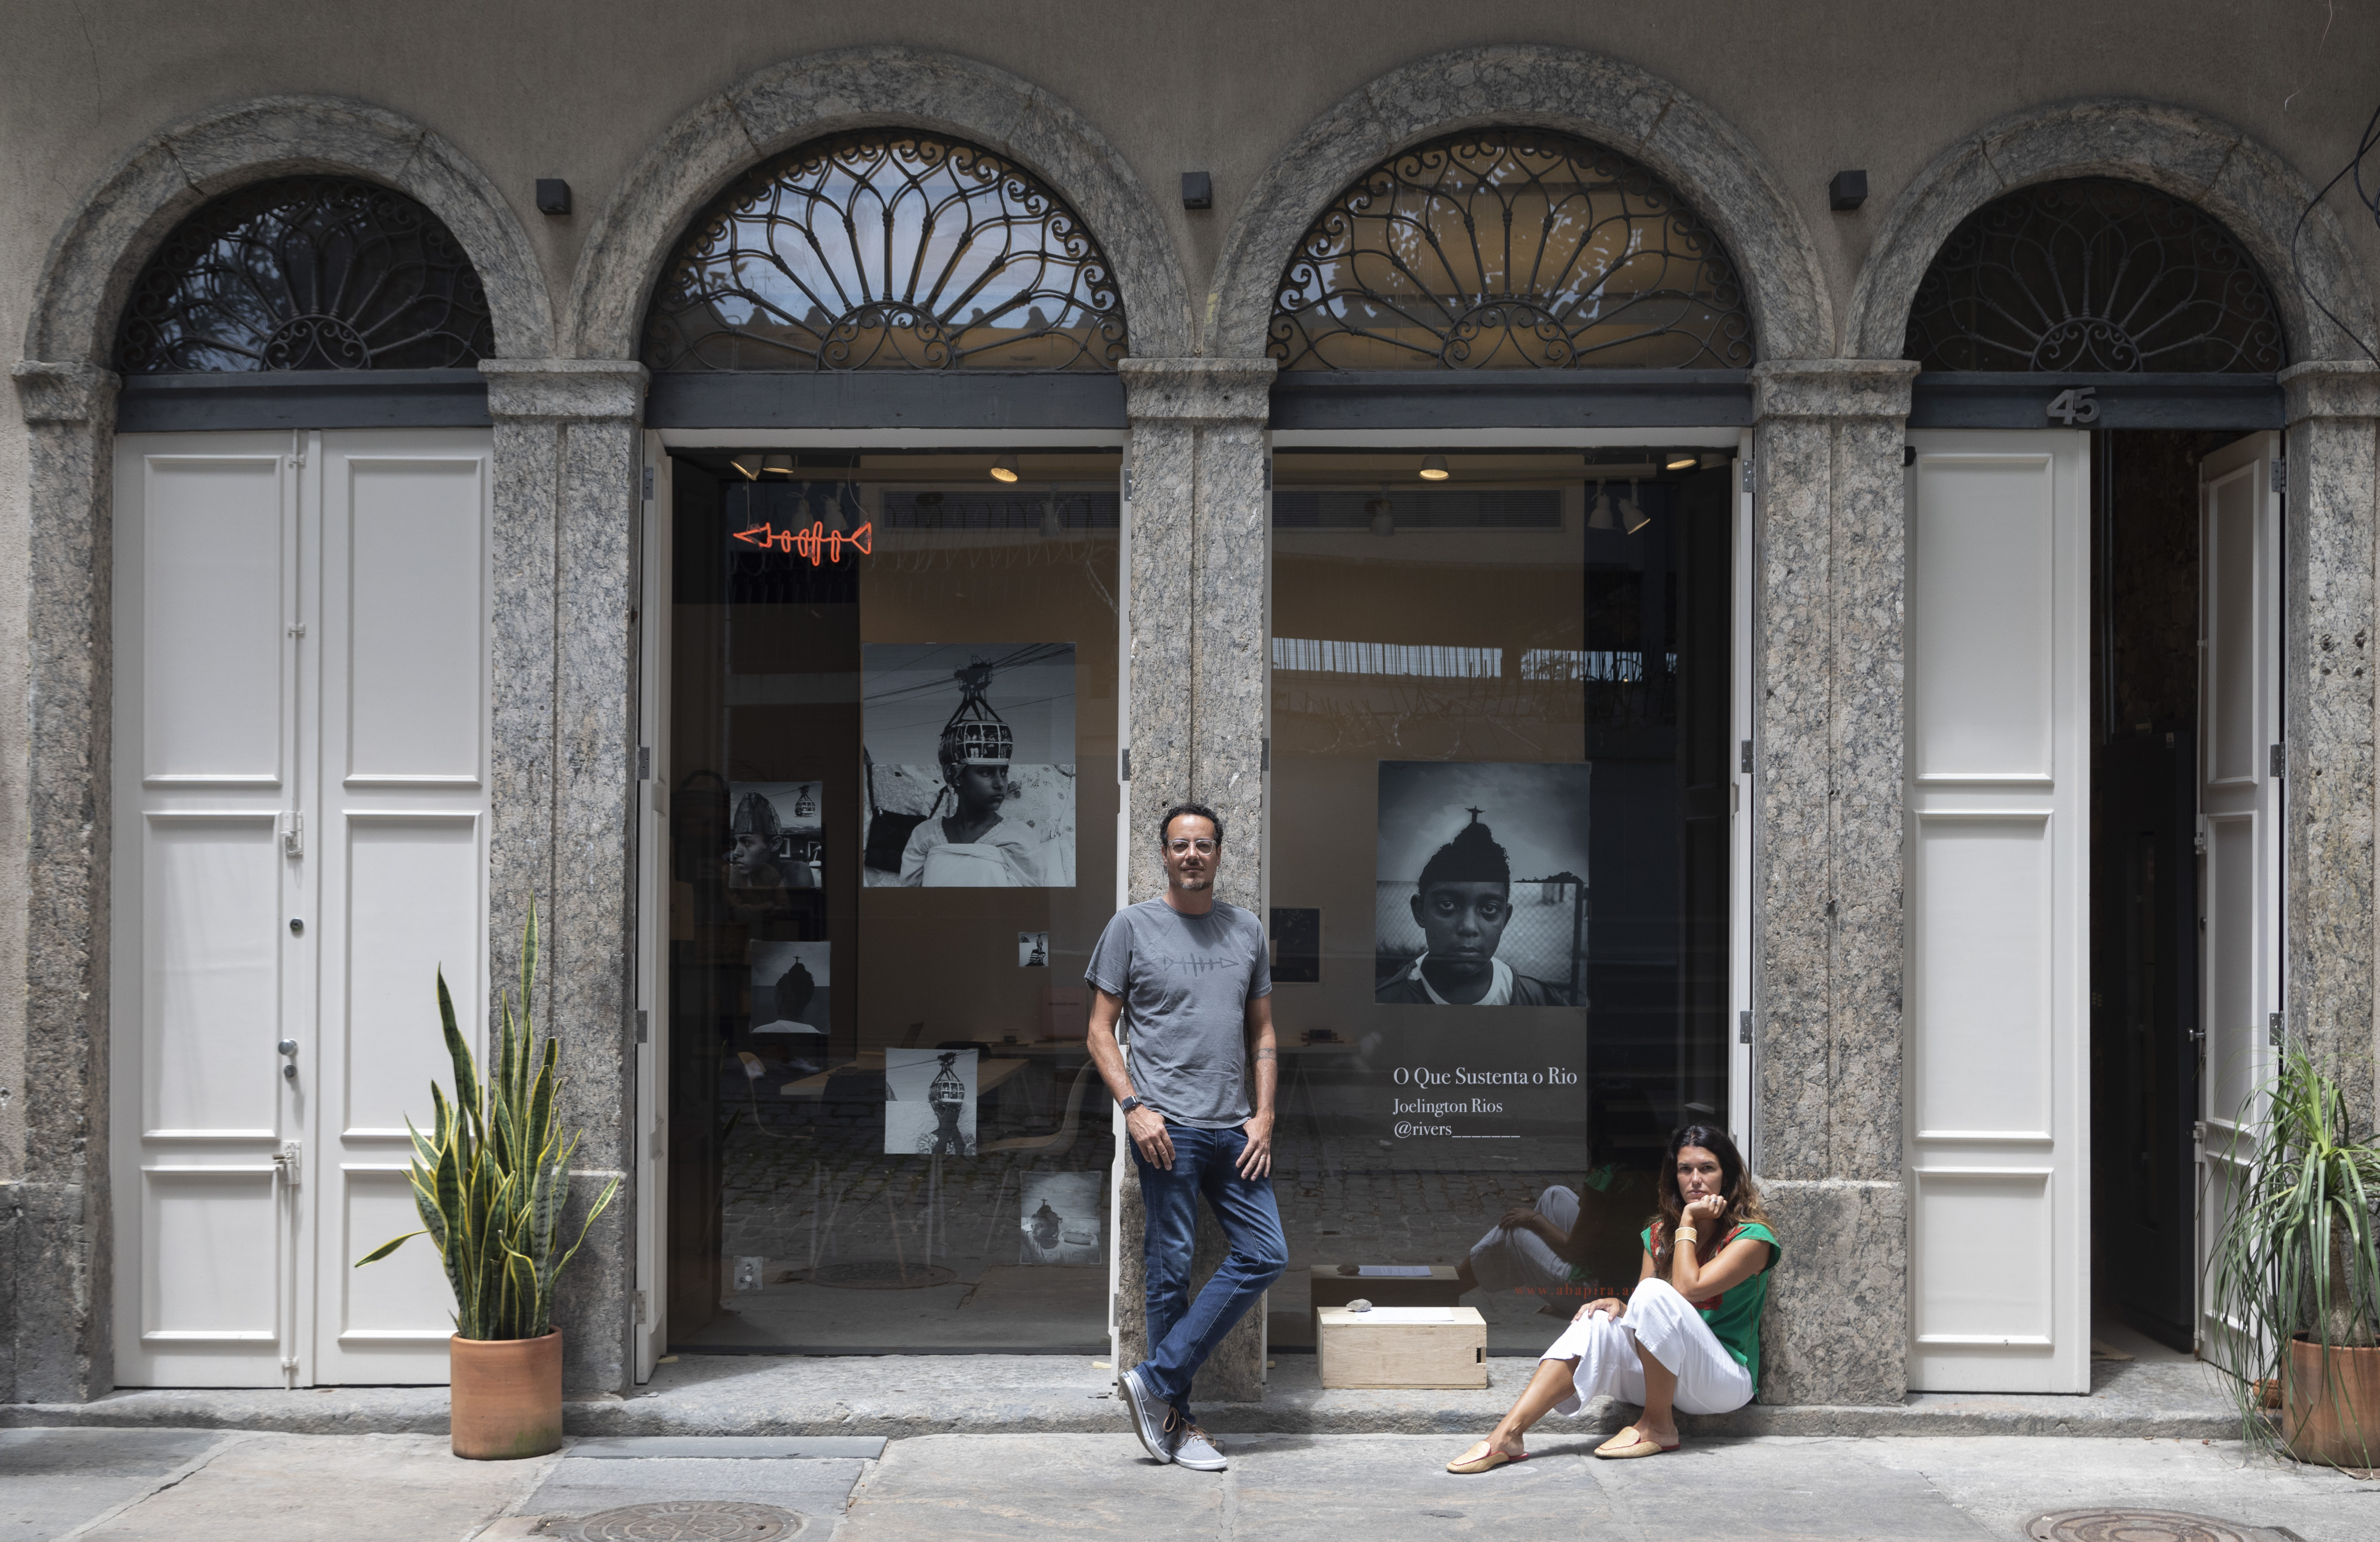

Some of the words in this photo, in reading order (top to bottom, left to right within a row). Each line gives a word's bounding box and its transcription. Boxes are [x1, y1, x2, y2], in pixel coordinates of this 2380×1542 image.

[2046, 386, 2100, 425] 45
[1393, 1067, 1409, 1085] O
[1414, 1067, 1451, 1089] Que
[1455, 1067, 1530, 1085] Sustenta
[1532, 1072, 1543, 1084] o
[1548, 1067, 1577, 1084] Rio
[1392, 1098, 1468, 1118] Joelington
[1471, 1098, 1503, 1113] Rios
